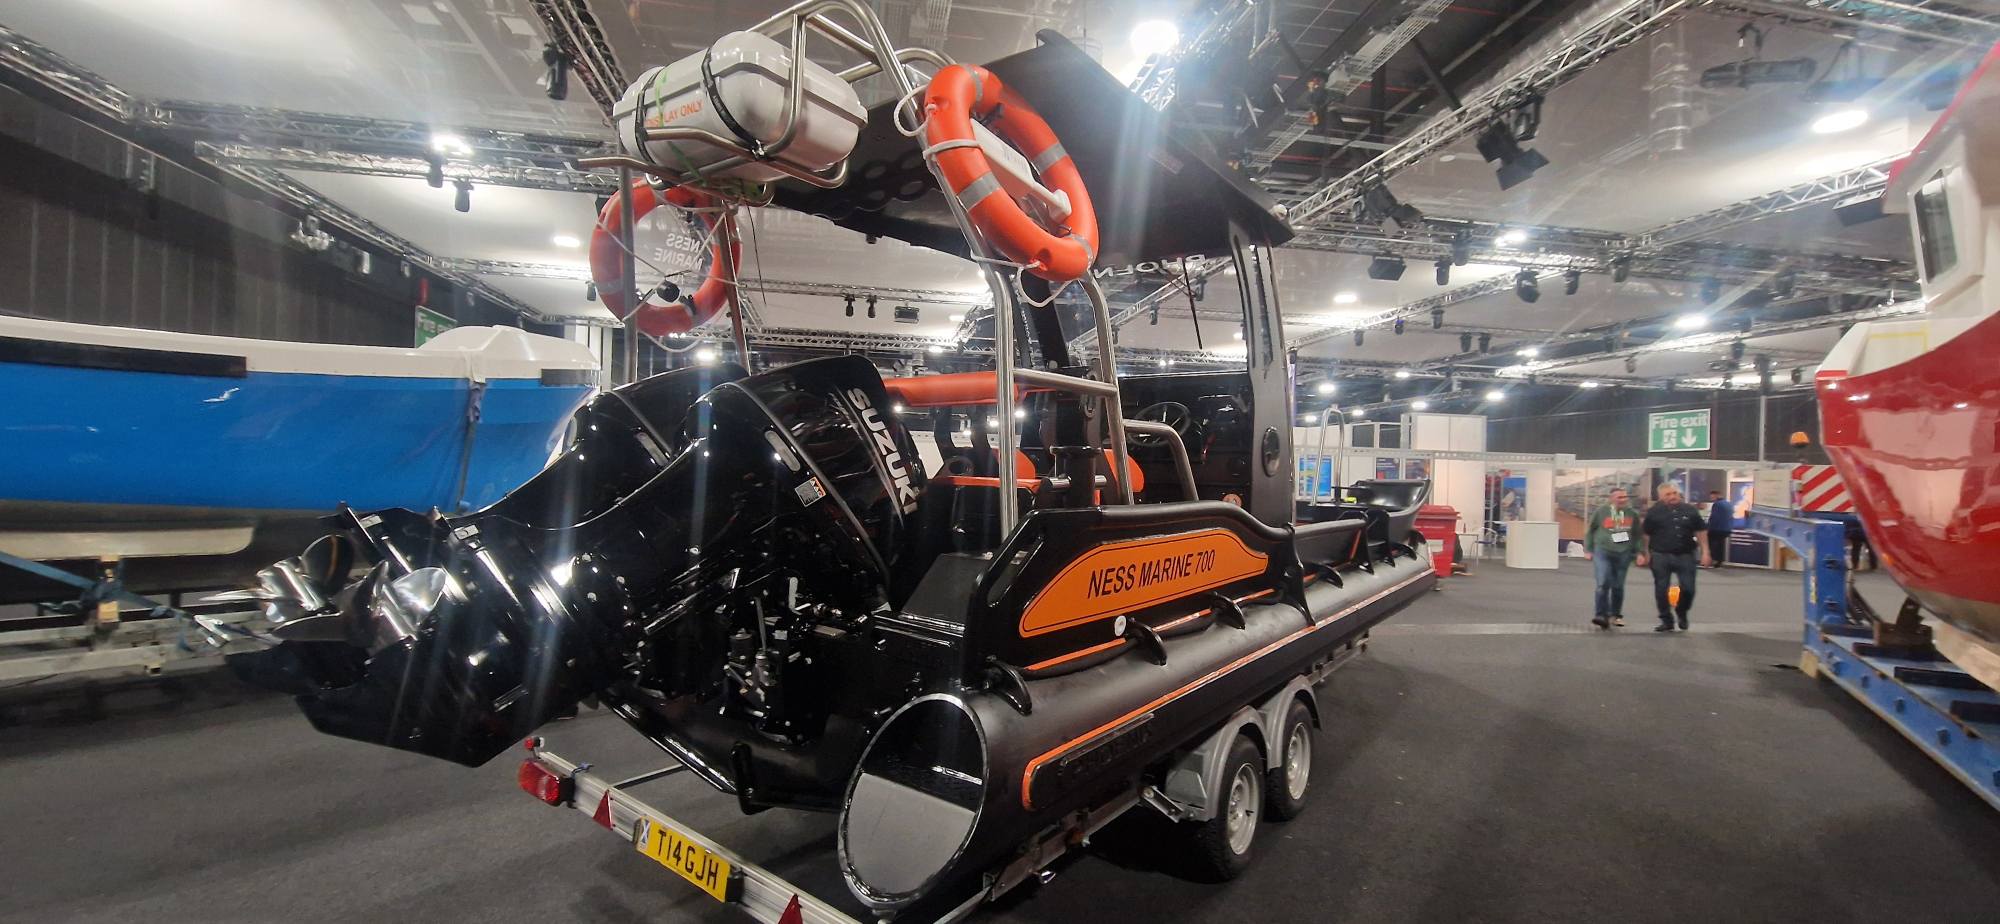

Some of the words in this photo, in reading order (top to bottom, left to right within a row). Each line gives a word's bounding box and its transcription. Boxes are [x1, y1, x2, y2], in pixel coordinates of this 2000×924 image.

[680, 99, 704, 117] ONLY
[1652, 415, 1679, 429] Fire
[1680, 412, 1708, 428] exit
[847, 387, 919, 515] SUZUKI
[1087, 563, 1137, 599] NESS
[1138, 552, 1194, 589] MARINE
[1195, 549, 1216, 574] 700
